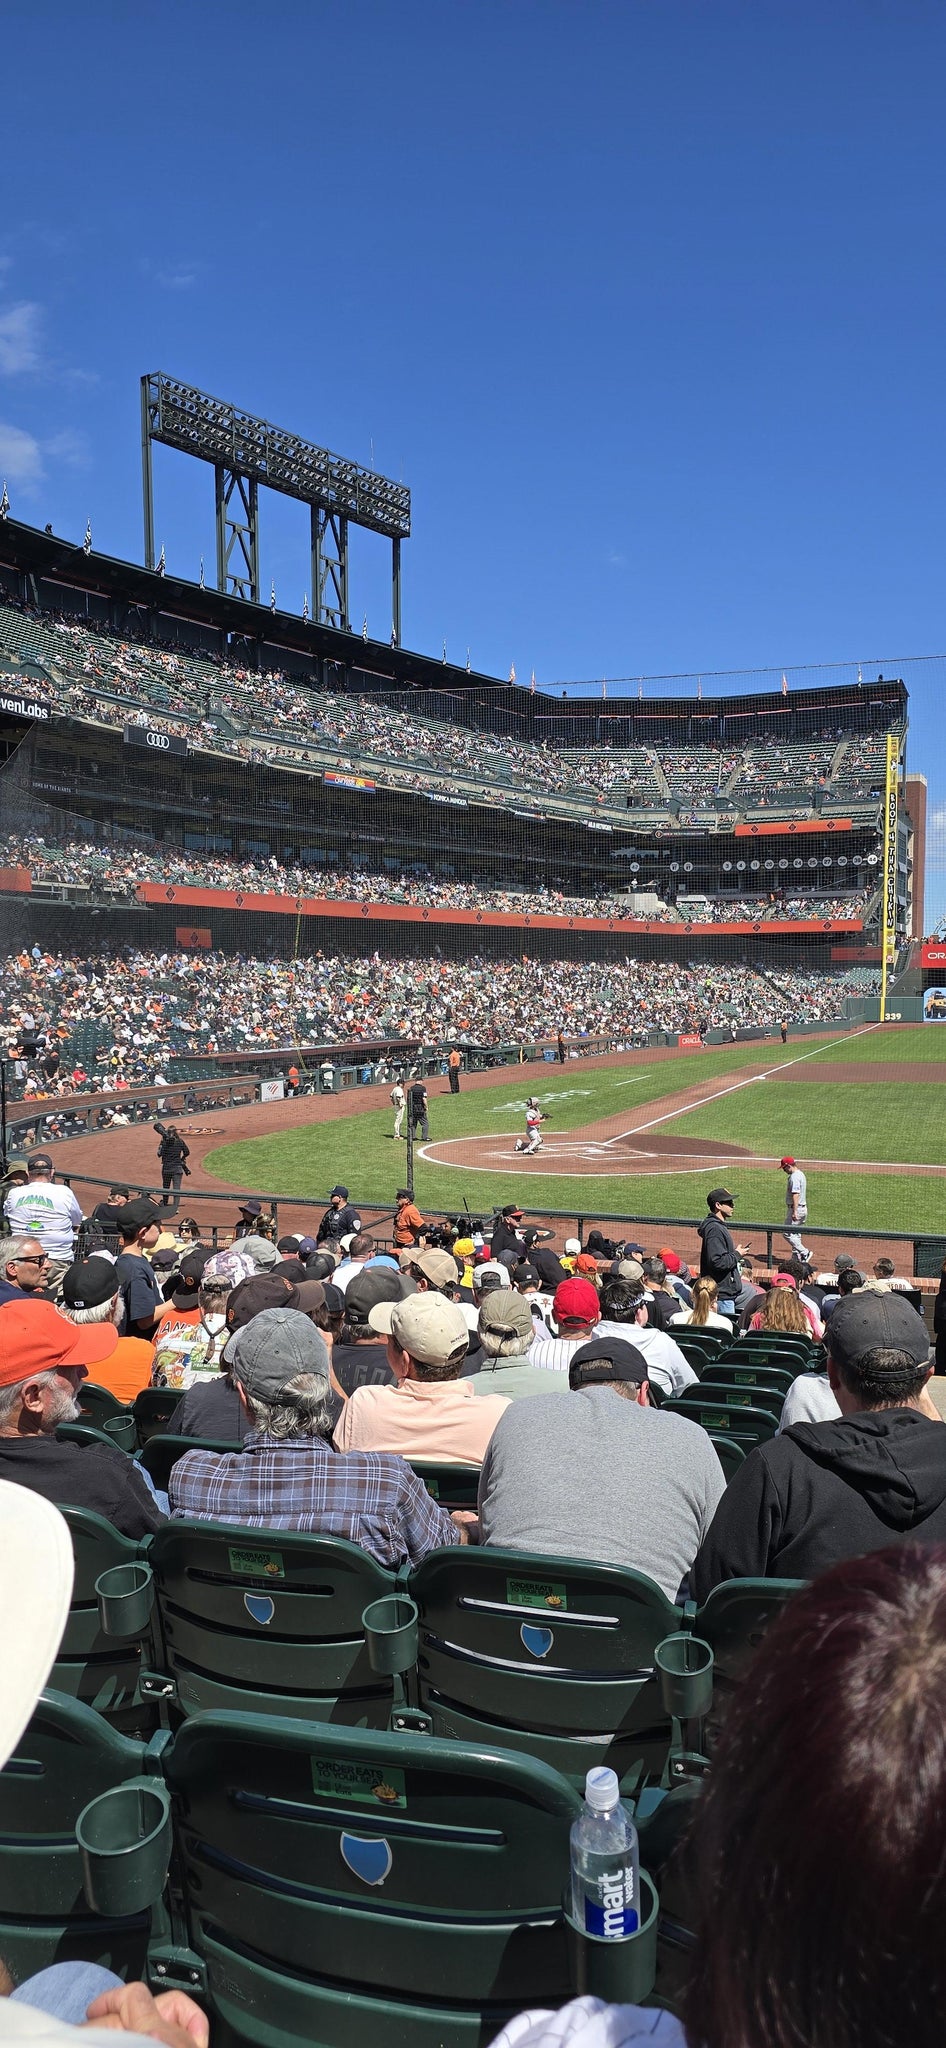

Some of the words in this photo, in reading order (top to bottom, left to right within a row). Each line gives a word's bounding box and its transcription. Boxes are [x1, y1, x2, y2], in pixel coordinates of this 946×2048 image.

[0, 698, 48, 718] venLabs
[927, 952, 946, 960] OR
[315, 1761, 355, 1775] ORDER
[355, 1767, 384, 1779] EATS
[318, 1769, 331, 1778] TO
[333, 1772, 359, 1783] YOUR
[335, 1788, 352, 1796] Eats
[624, 1867, 633, 1903] water
[598, 1870, 624, 1937] mart
